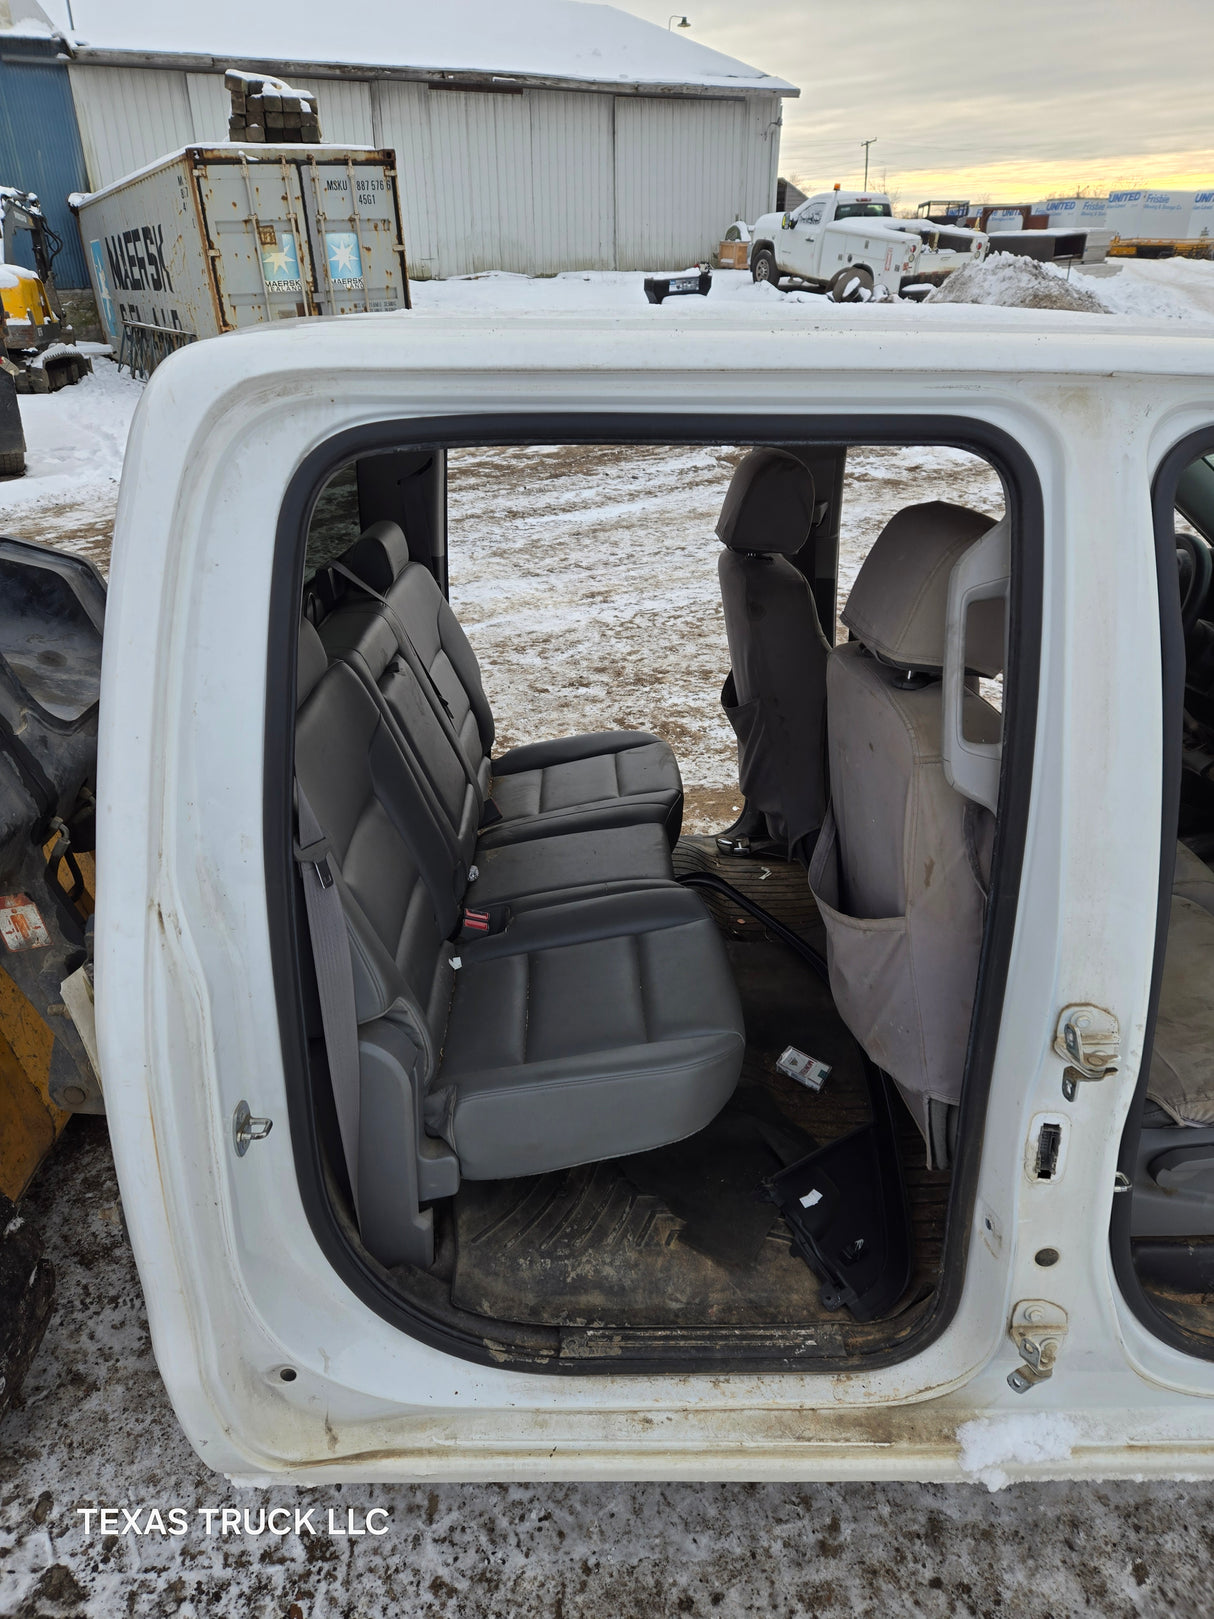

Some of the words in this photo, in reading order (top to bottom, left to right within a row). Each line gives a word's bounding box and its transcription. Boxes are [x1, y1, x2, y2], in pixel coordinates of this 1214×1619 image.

[326, 180, 348, 191] MSKU
[358, 194, 376, 205] 45G1
[1108, 192, 1141, 203] UNITED
[1046, 201, 1076, 211] UNITED
[105, 224, 175, 294] MAERSK
